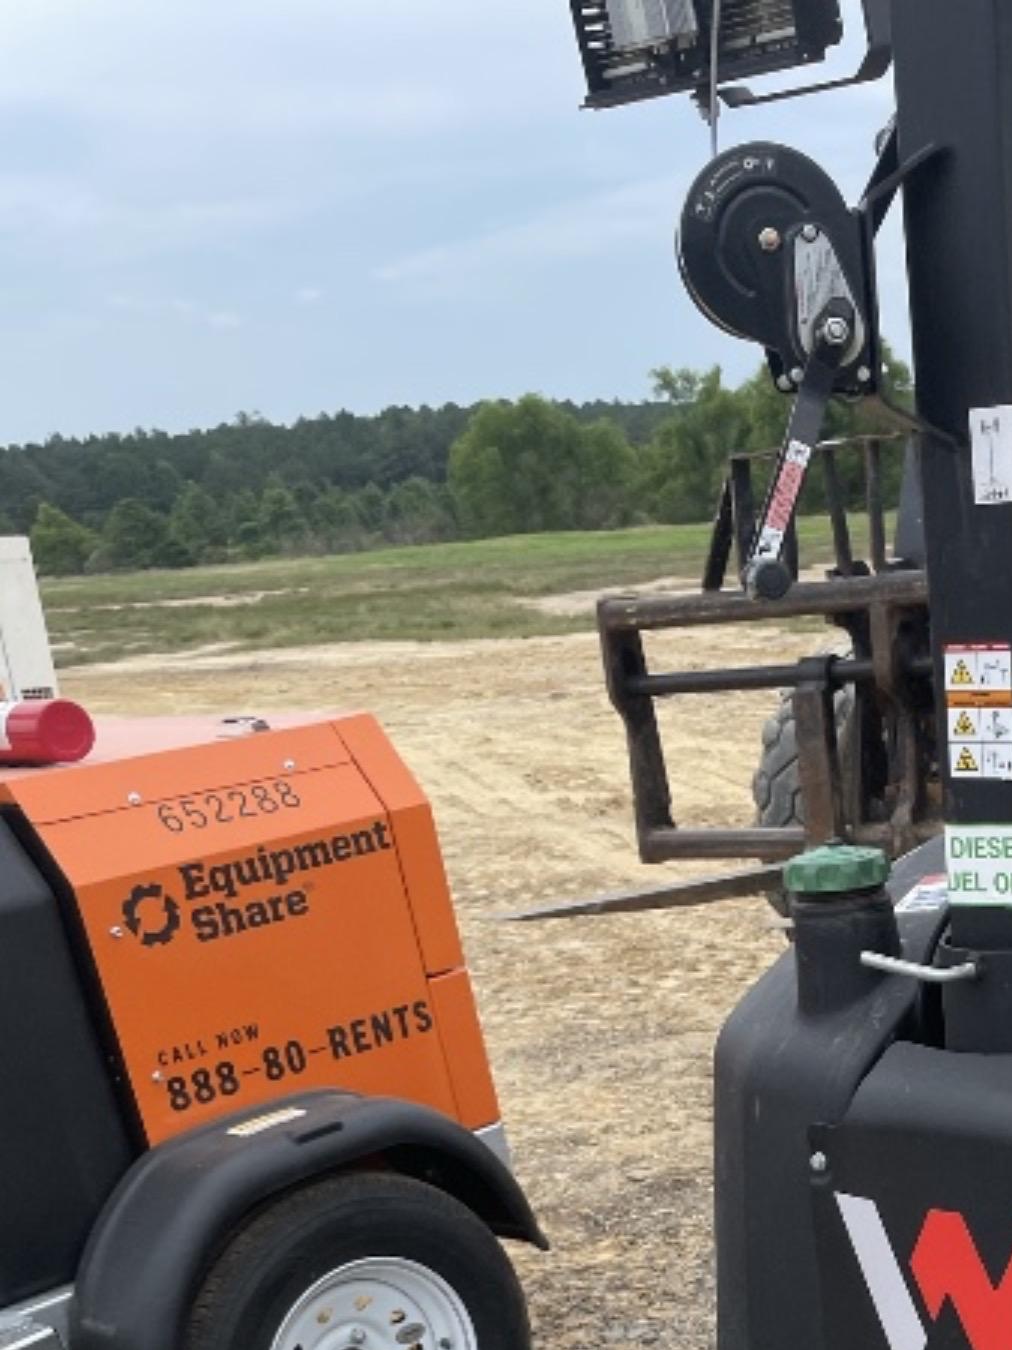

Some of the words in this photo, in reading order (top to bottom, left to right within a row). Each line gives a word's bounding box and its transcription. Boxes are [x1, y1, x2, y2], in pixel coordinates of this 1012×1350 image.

[158, 780, 300, 833] 652288
[178, 820, 391, 900] Equipment
[948, 871, 988, 892] UEL
[191, 888, 310, 942] Share
[158, 1039, 208, 1066] CALL
[215, 1023, 260, 1051] NOW
[166, 1000, 432, 1111] 888-80-RENTS
